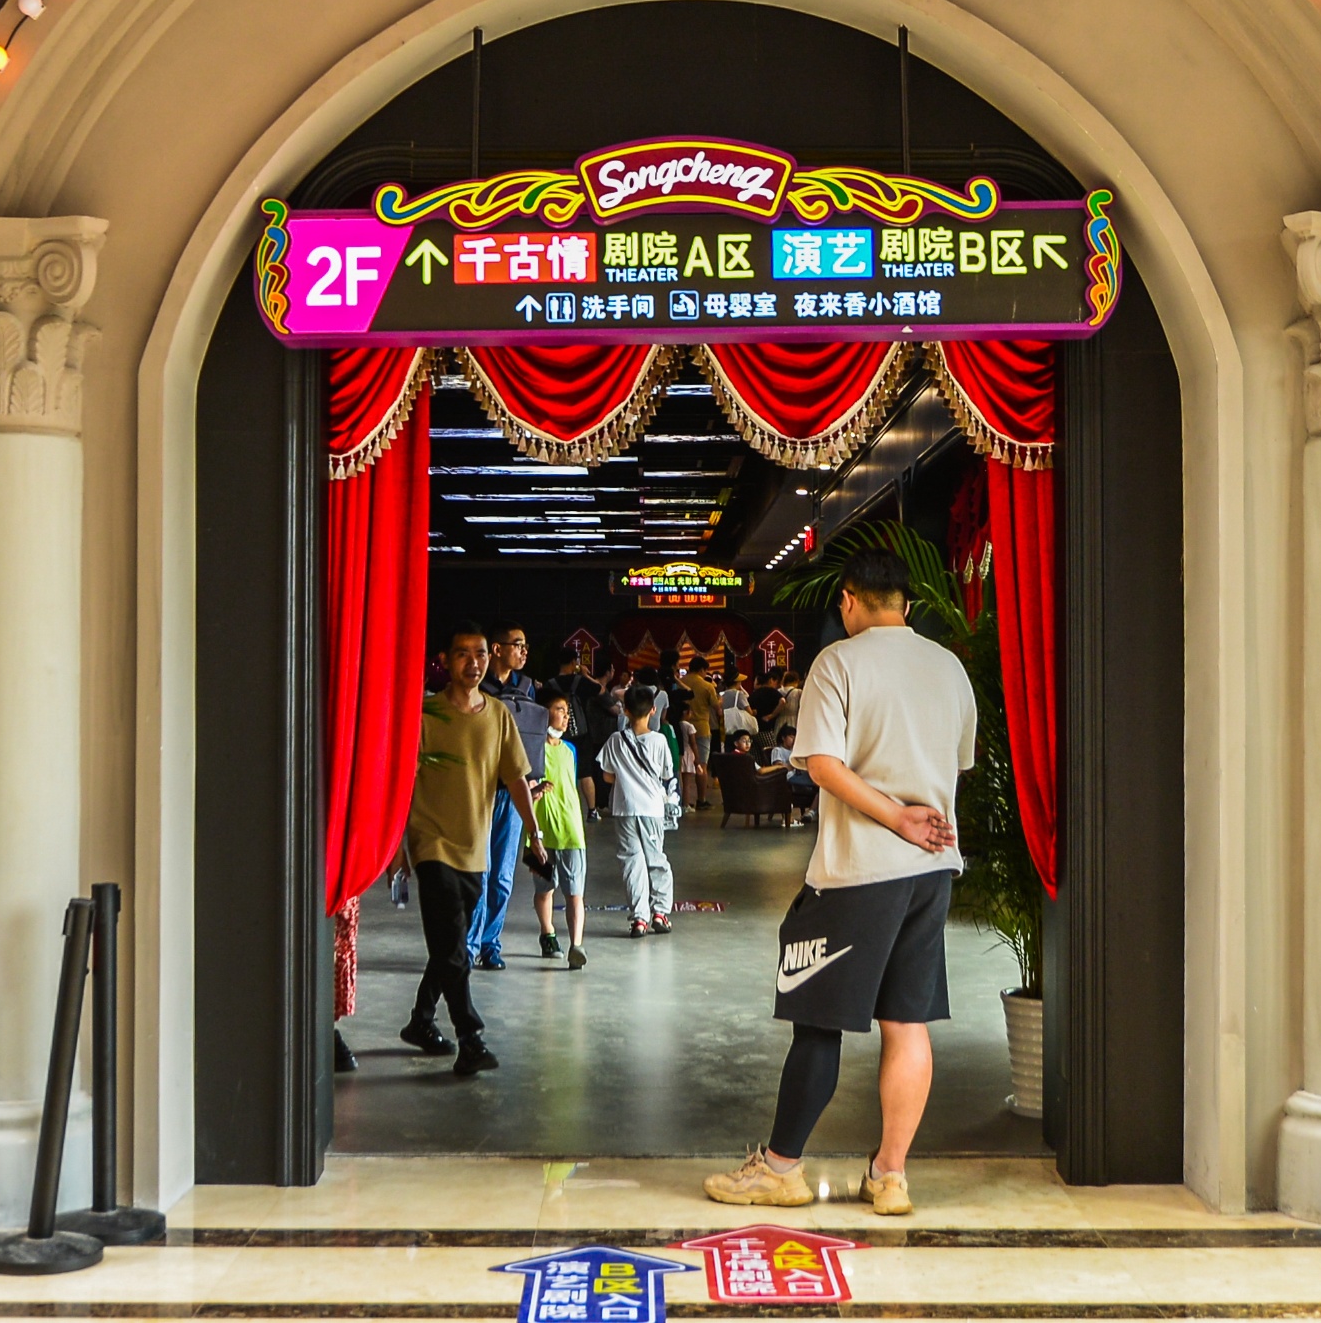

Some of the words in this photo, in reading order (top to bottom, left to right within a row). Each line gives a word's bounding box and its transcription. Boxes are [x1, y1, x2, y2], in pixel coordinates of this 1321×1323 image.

[598, 150, 775, 209] Songcheng
[305, 245, 382, 307] 2F
[458, 234, 590, 282] 千古情
[602, 231, 679, 267] 剧院
[683, 234, 755, 279] A区
[782, 231, 867, 276] 演艺
[879, 226, 955, 263] 剧院
[959, 229, 1028, 275] B区
[604, 267, 679, 283] THEATER
[881, 262, 955, 279] THEATER
[581, 294, 656, 321] 洗手间
[702, 291, 779, 320] 母婴室
[793, 289, 942, 319] 夜来香小酒馆
[783, 936, 828, 972] NIKE
[540, 1261, 590, 1320] 演艺剧院
[593, 1262, 644, 1320] B区入口
[722, 1237, 777, 1295] 千古情剧院
[772, 1240, 824, 1294] A区入口
